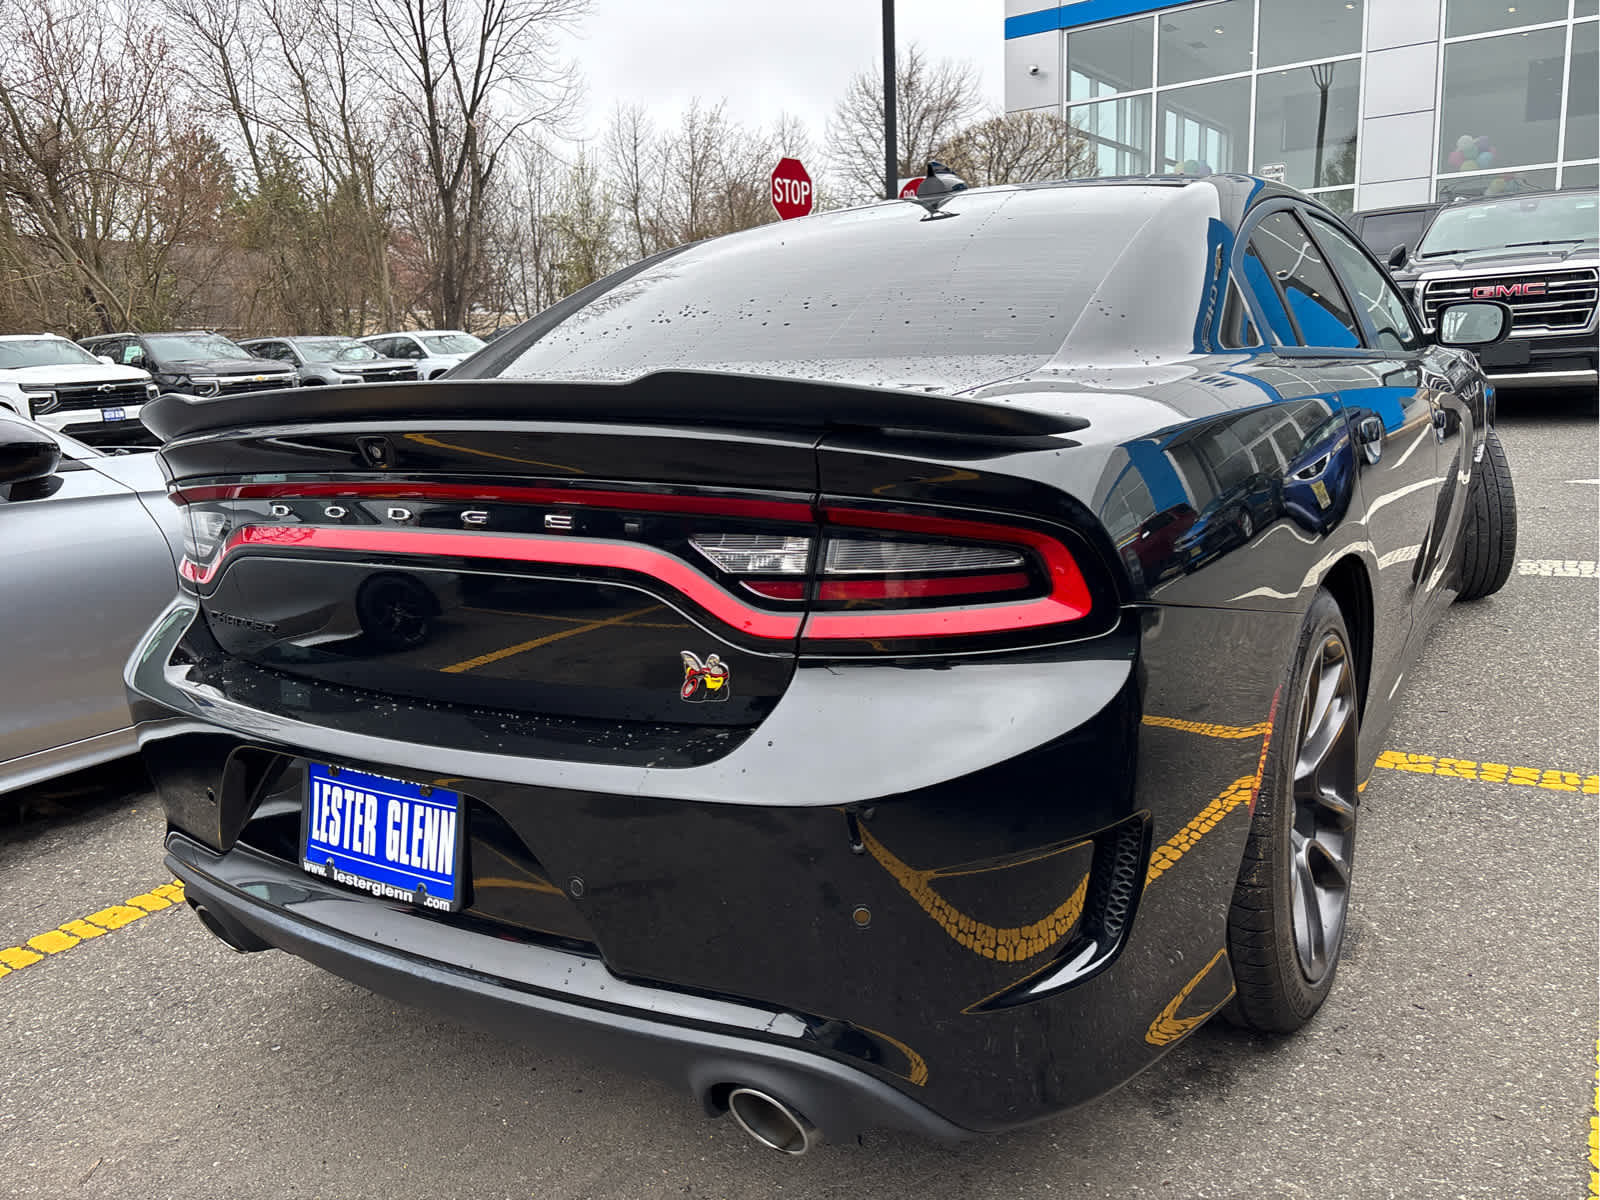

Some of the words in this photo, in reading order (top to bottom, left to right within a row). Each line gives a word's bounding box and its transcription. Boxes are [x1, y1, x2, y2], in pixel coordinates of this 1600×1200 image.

[774, 177, 811, 205] STOP
[1472, 282, 1547, 299] GMC
[271, 503, 573, 531] DODGE
[312, 781, 378, 857] LESTER
[385, 799, 457, 876] GLENN
[303, 860, 327, 877] www.
[332, 868, 413, 903] lesterglenn
